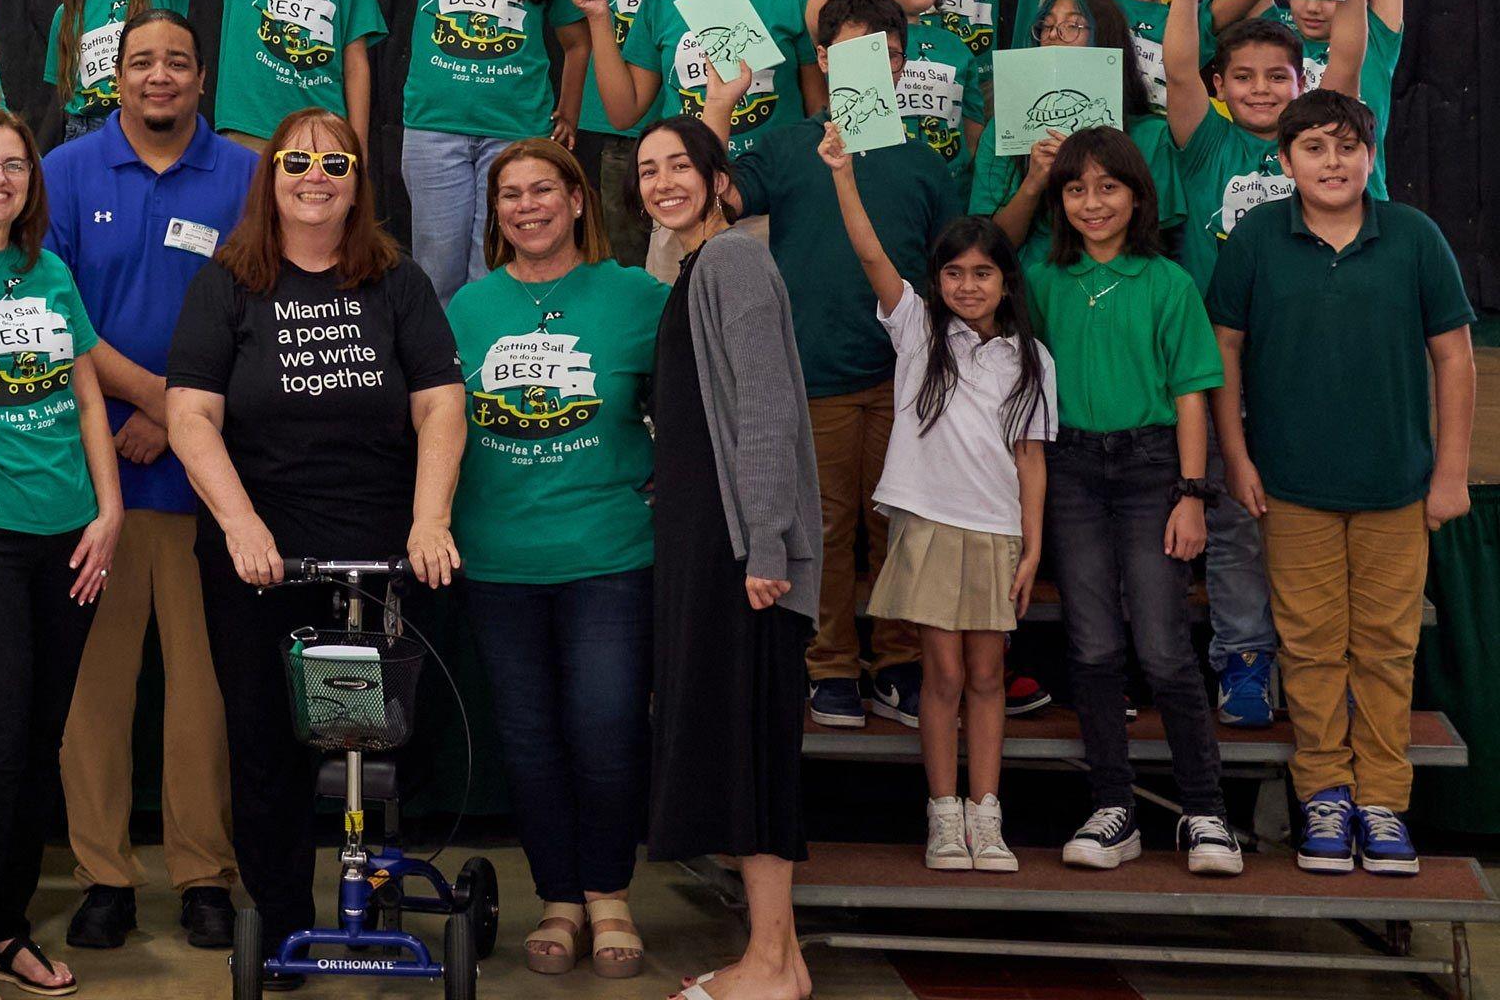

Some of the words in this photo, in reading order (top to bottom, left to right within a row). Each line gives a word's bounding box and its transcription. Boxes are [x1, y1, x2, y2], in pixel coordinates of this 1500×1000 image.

[80, 34, 114, 53] Setting
[86, 55, 120, 78] BES
[256, 51, 291, 76] Charles
[431, 55, 466, 73] Charles
[470, 64, 483, 74] R.
[487, 65, 524, 76] Hadley
[928, 70, 948, 84] Sail
[1270, 184, 1292, 195] Sail
[8, 278, 21, 287] A+
[14, 306, 40, 318] Sail
[274, 298, 340, 321] Miami
[344, 297, 362, 316] is
[545, 311, 561, 320] A+
[277, 329, 292, 344] a
[296, 323, 361, 347] poem
[279, 351, 315, 368] we
[318, 343, 377, 365] write
[494, 342, 538, 354] Setting
[542, 341, 564, 354] Sail
[280, 368, 384, 396] together
[494, 363, 561, 381] BEST
[29, 409, 42, 420] R.
[44, 398, 75, 417] Hadley
[481, 436, 528, 455] Charles
[533, 445, 547, 456] R.
[552, 435, 600, 453] Hadley
[317, 959, 394, 970] ORTHOMATE
